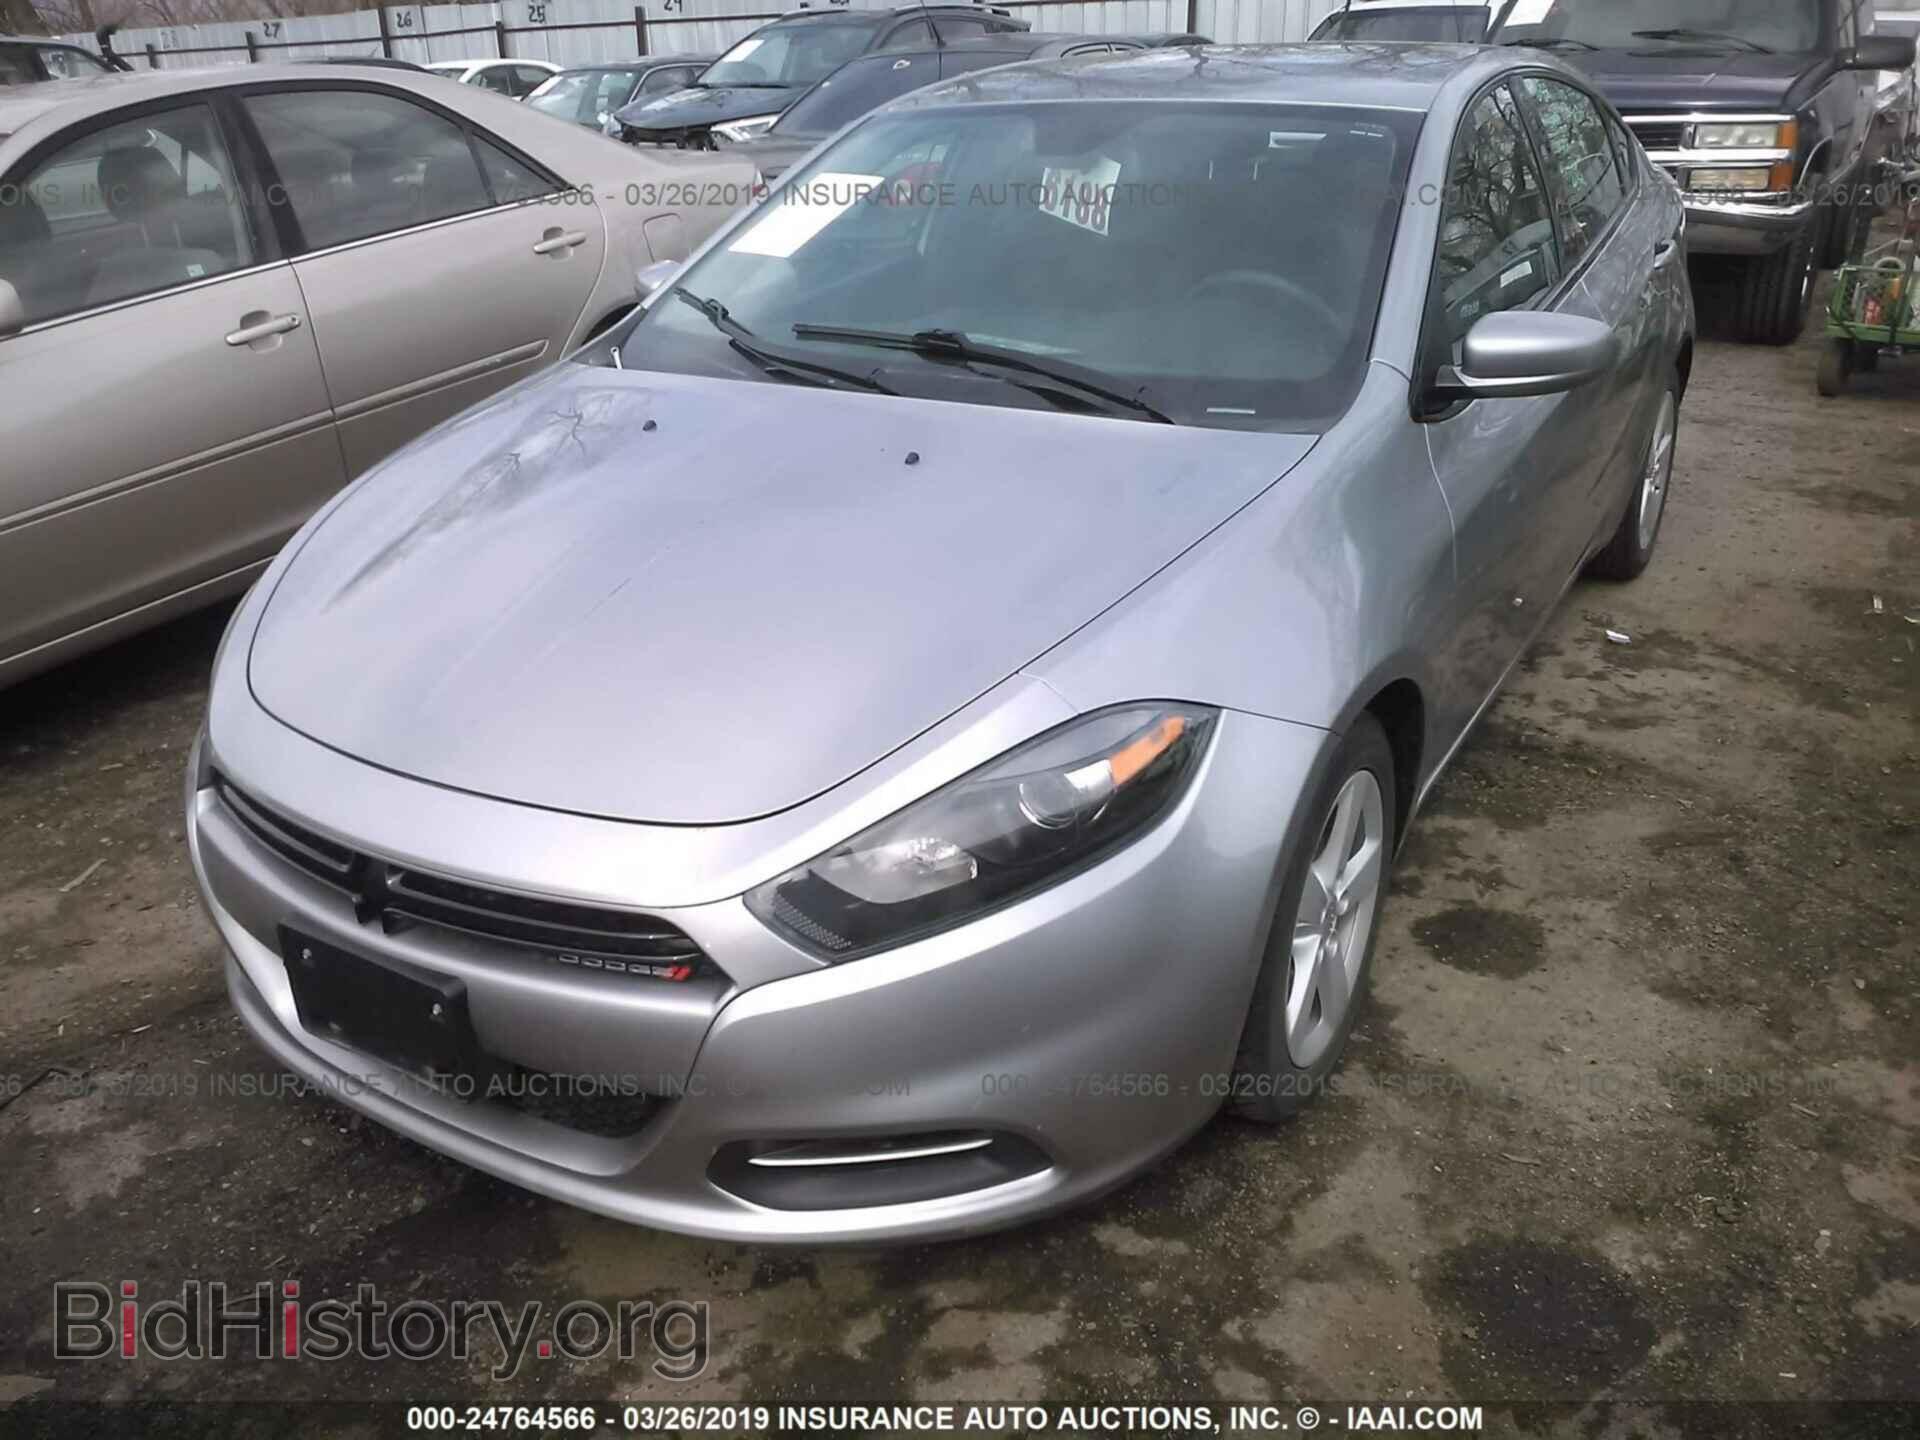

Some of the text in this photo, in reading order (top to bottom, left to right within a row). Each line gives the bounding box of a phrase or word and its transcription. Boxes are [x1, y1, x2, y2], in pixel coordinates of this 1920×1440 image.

[396, 11, 412, 28] 26
[529, 5, 545, 23] 25
[264, 22, 280, 38] 27
